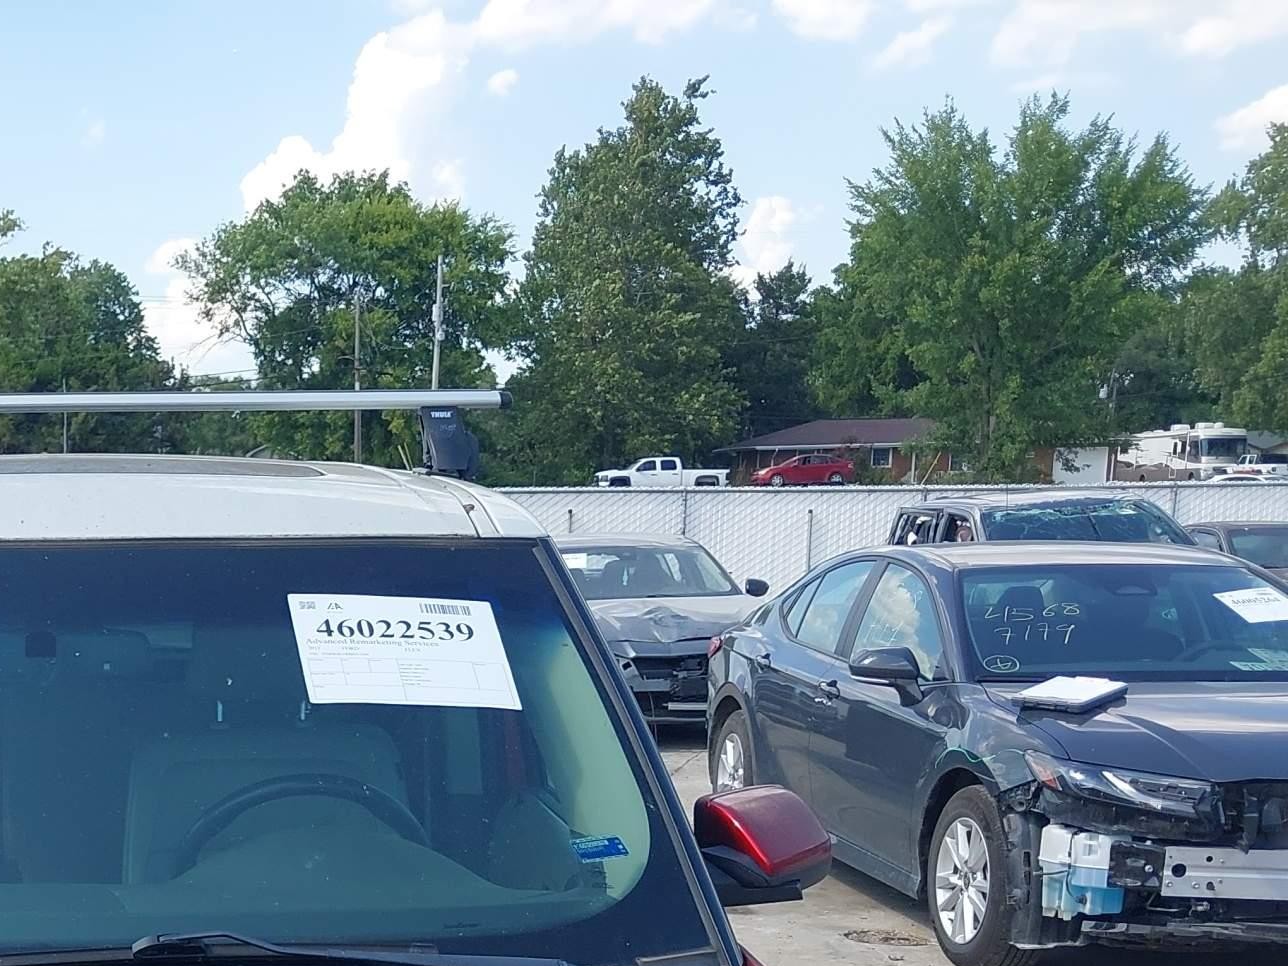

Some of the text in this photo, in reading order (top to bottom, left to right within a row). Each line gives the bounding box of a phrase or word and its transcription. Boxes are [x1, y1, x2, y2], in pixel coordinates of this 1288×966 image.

[316, 618, 474, 642] 46022539
[994, 622, 1076, 645] 7179
[349, 639, 402, 648] Remarketing
